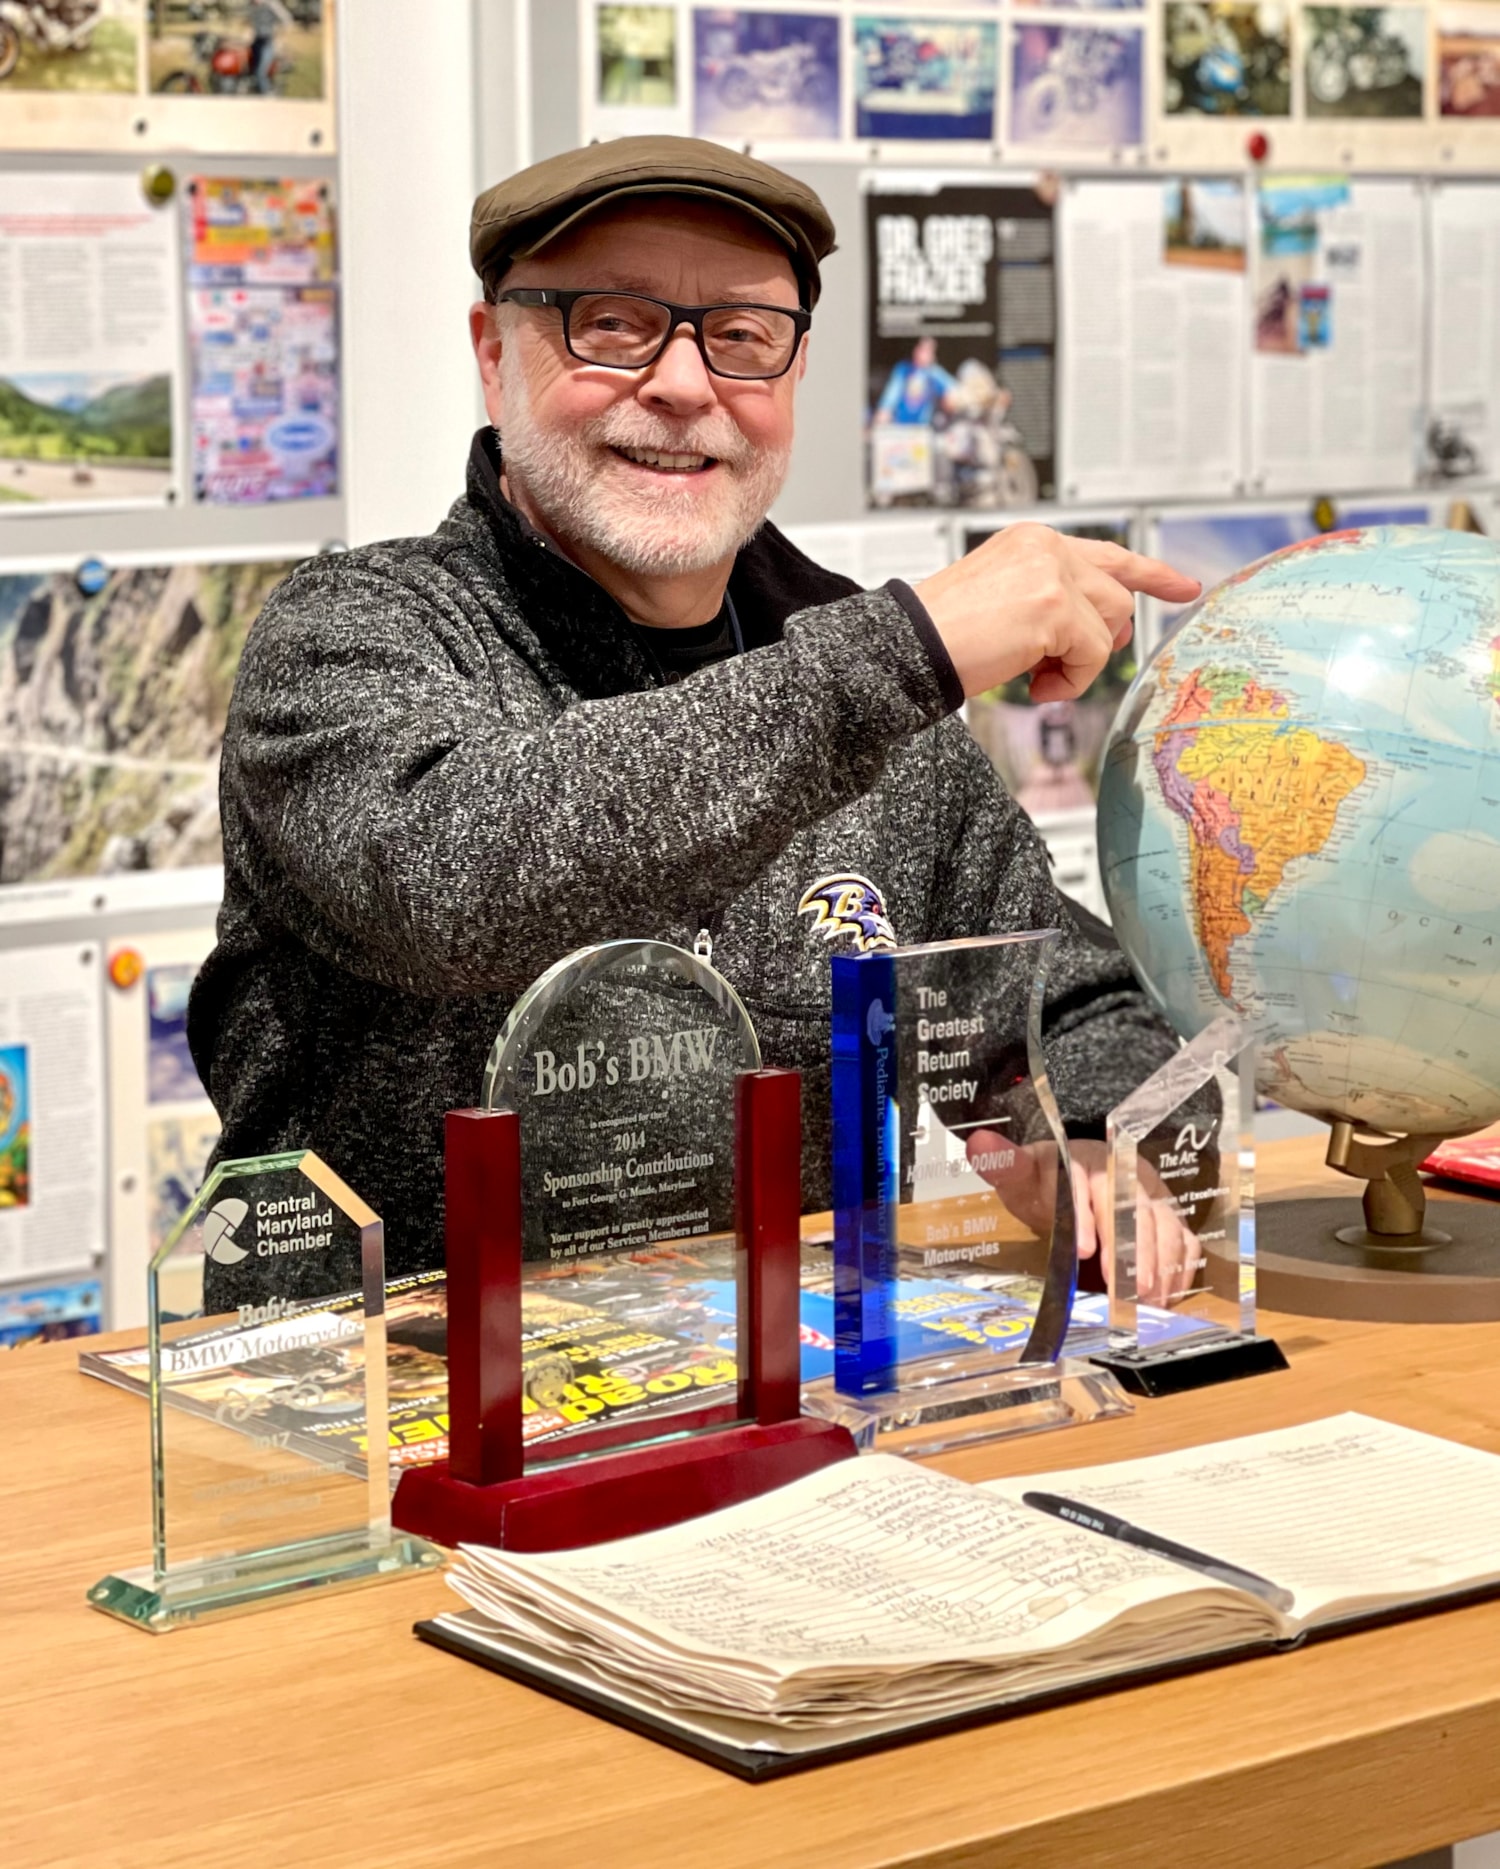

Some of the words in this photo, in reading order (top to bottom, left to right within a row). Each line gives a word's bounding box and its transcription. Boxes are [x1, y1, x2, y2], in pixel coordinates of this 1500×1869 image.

[1195, 754, 1300, 766] SOUTH
[1188, 791, 1327, 806] AMERICA
[917, 987, 947, 1009] The
[917, 1015, 984, 1042] Greatest
[533, 1040, 619, 1096] Bob's
[628, 1026, 720, 1083] BMW
[917, 1048, 970, 1073] Return
[875, 1047, 891, 1121] Pediatric
[917, 1080, 978, 1105] Society
[613, 1130, 646, 1152] 2014
[970, 1150, 1015, 1174] DONOR
[1160, 1153, 1178, 1169] The
[1179, 1151, 1199, 1166] Arc
[543, 1161, 623, 1198] Sponsorship
[625, 1150, 715, 1178] Contributions
[256, 1193, 316, 1217] Central
[571, 1195, 590, 1208] Fort
[590, 1191, 618, 1205] George
[876, 1180, 890, 1231] Tumor
[1179, 1193, 1189, 1203] of
[1190, 1187, 1230, 1200] Excellence
[256, 1208, 332, 1238] Maryland
[550, 1231, 573, 1245] Your
[574, 1224, 610, 1242] support
[611, 1223, 620, 1234] is
[621, 1216, 655, 1234] greatly
[656, 1207, 710, 1227] appreciated
[925, 1221, 960, 1243] Bob's
[962, 1215, 999, 1237] BMW
[256, 1231, 333, 1258] Chamber
[549, 1247, 563, 1260] by
[564, 1243, 577, 1257] all
[577, 1242, 588, 1254] of
[589, 1242, 606, 1253] our
[607, 1233, 647, 1250] Services
[649, 1226, 691, 1242] Members
[691, 1221, 709, 1234] and
[924, 1240, 1000, 1267] Motorcycles
[237, 1296, 297, 1327] Bob's
[170, 1341, 235, 1373] BMW
[240, 1316, 365, 1361] Motorcycles
[558, 1358, 738, 1424] Road
